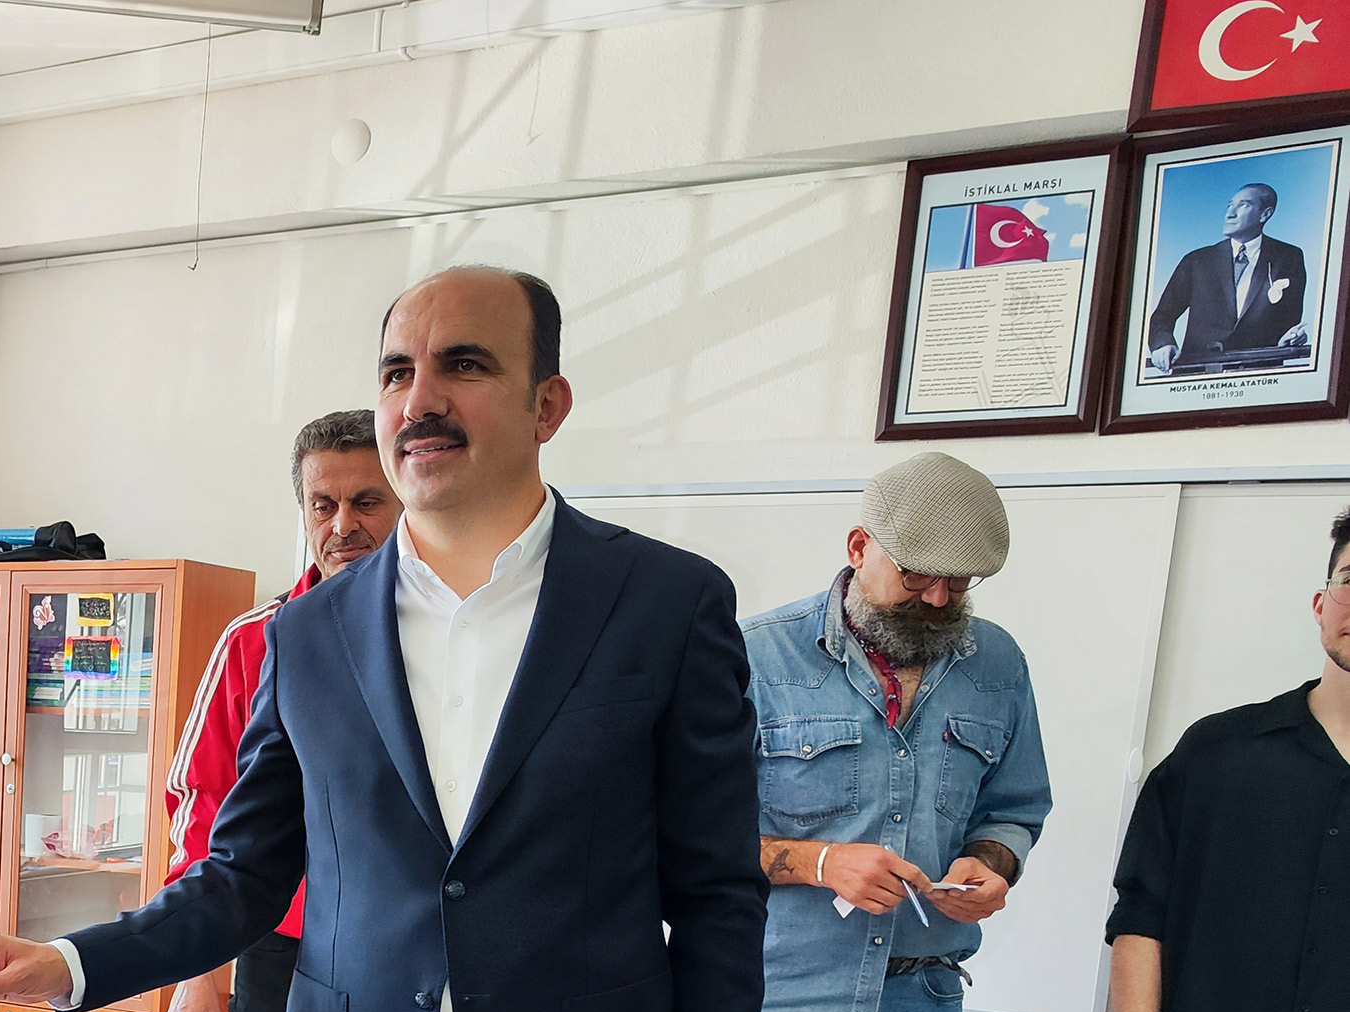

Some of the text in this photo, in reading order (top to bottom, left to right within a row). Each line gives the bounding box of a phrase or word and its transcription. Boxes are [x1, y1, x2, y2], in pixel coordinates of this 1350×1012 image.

[964, 178, 1062, 198] İSTİKLAL MARŞI
[1169, 377, 1279, 393] MUSTAFA KEMAL ATATÜRK
[1202, 390, 1244, 400] 1881-1938
